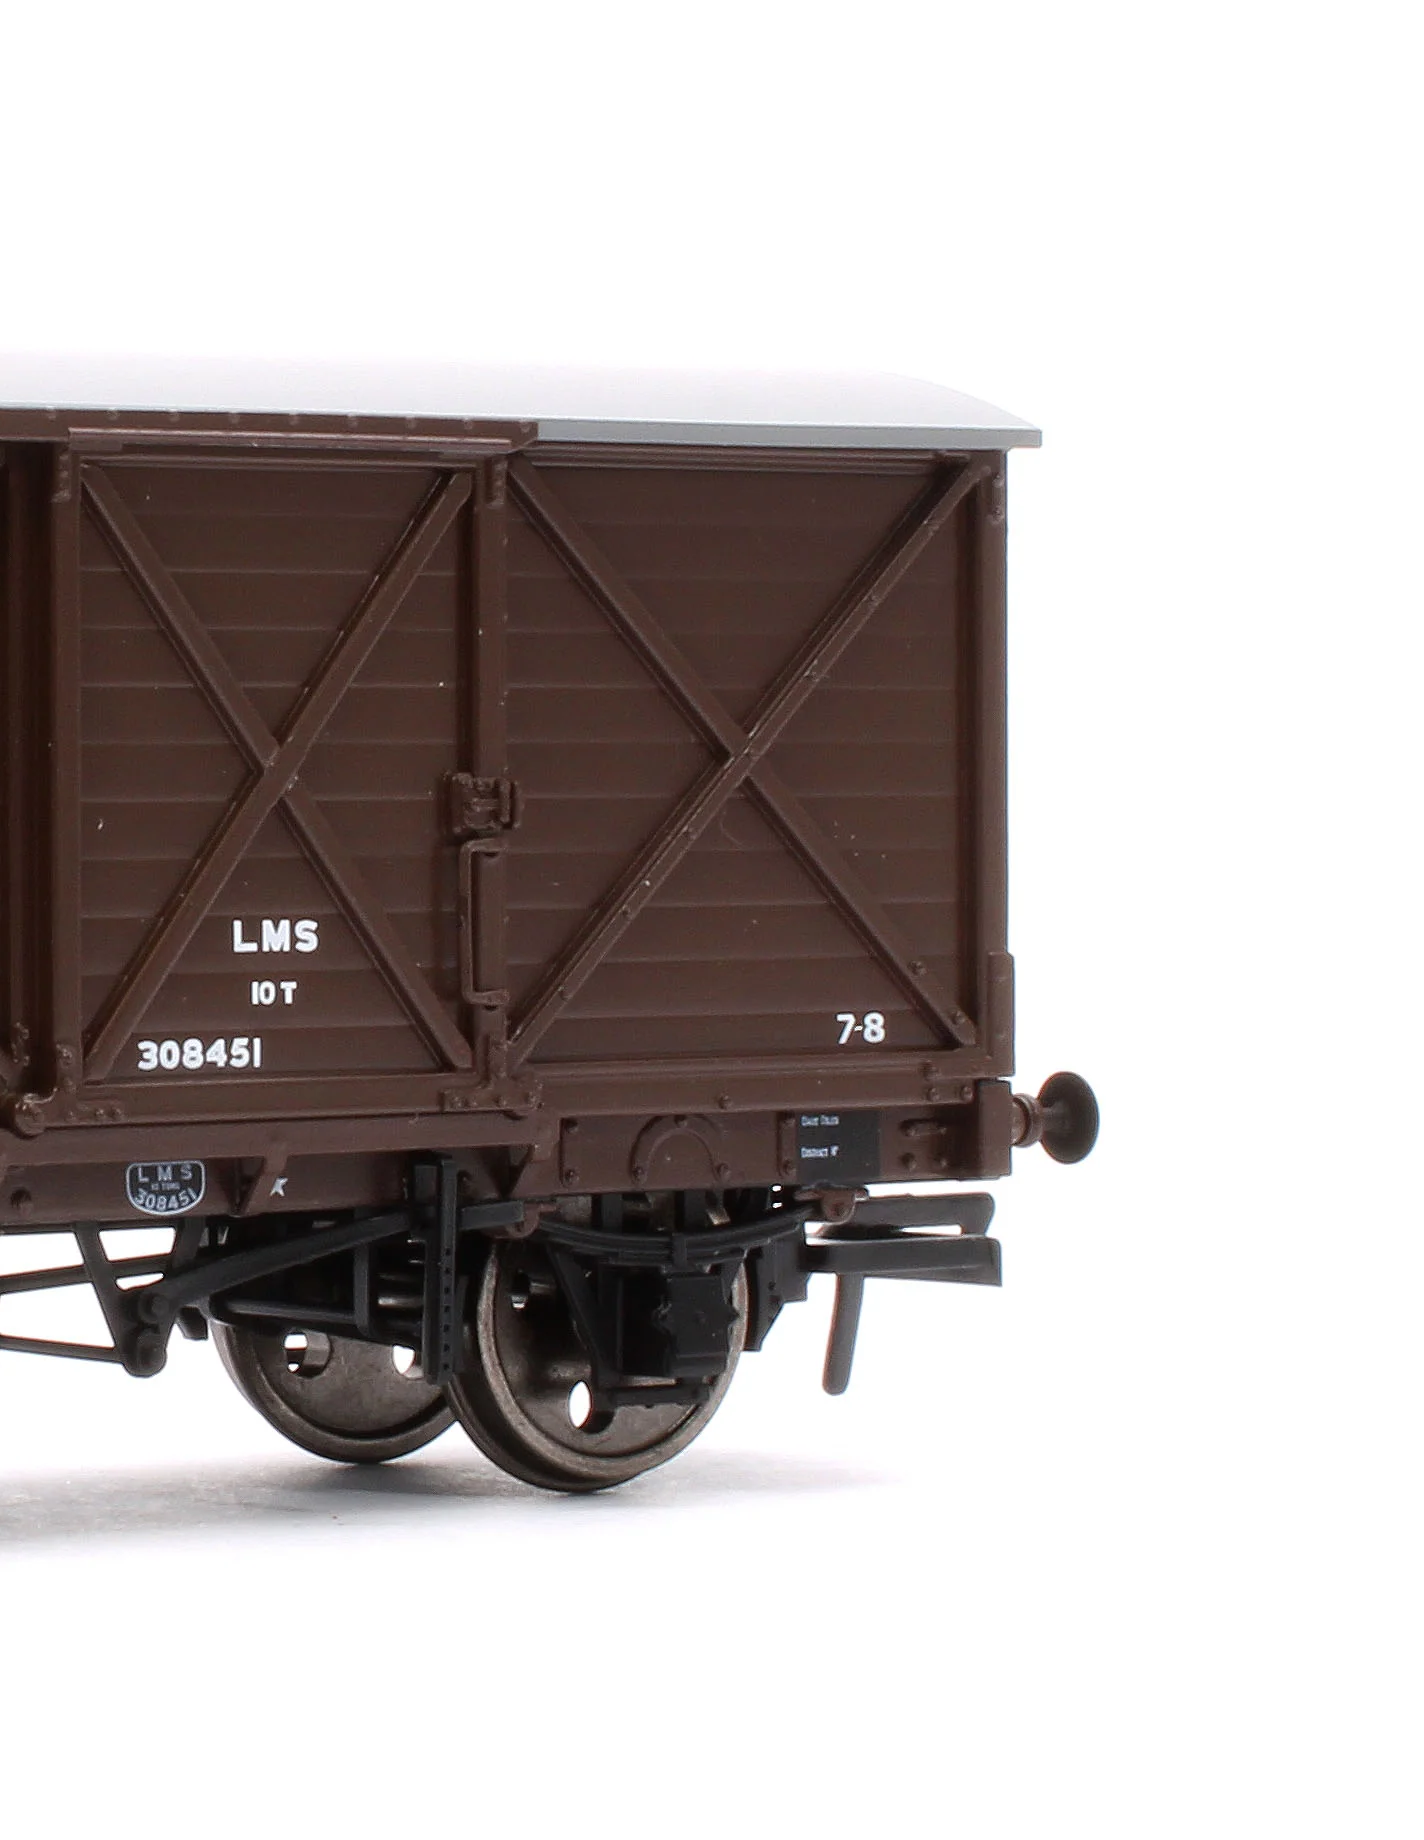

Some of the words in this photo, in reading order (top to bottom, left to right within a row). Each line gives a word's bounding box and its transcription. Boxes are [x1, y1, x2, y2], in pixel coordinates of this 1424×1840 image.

[233, 919, 318, 953] LMS
[279, 981, 298, 1005] T
[836, 1012, 886, 1045] 7-8
[137, 1037, 262, 1071] 308451
[134, 1187, 198, 1211] 308451
